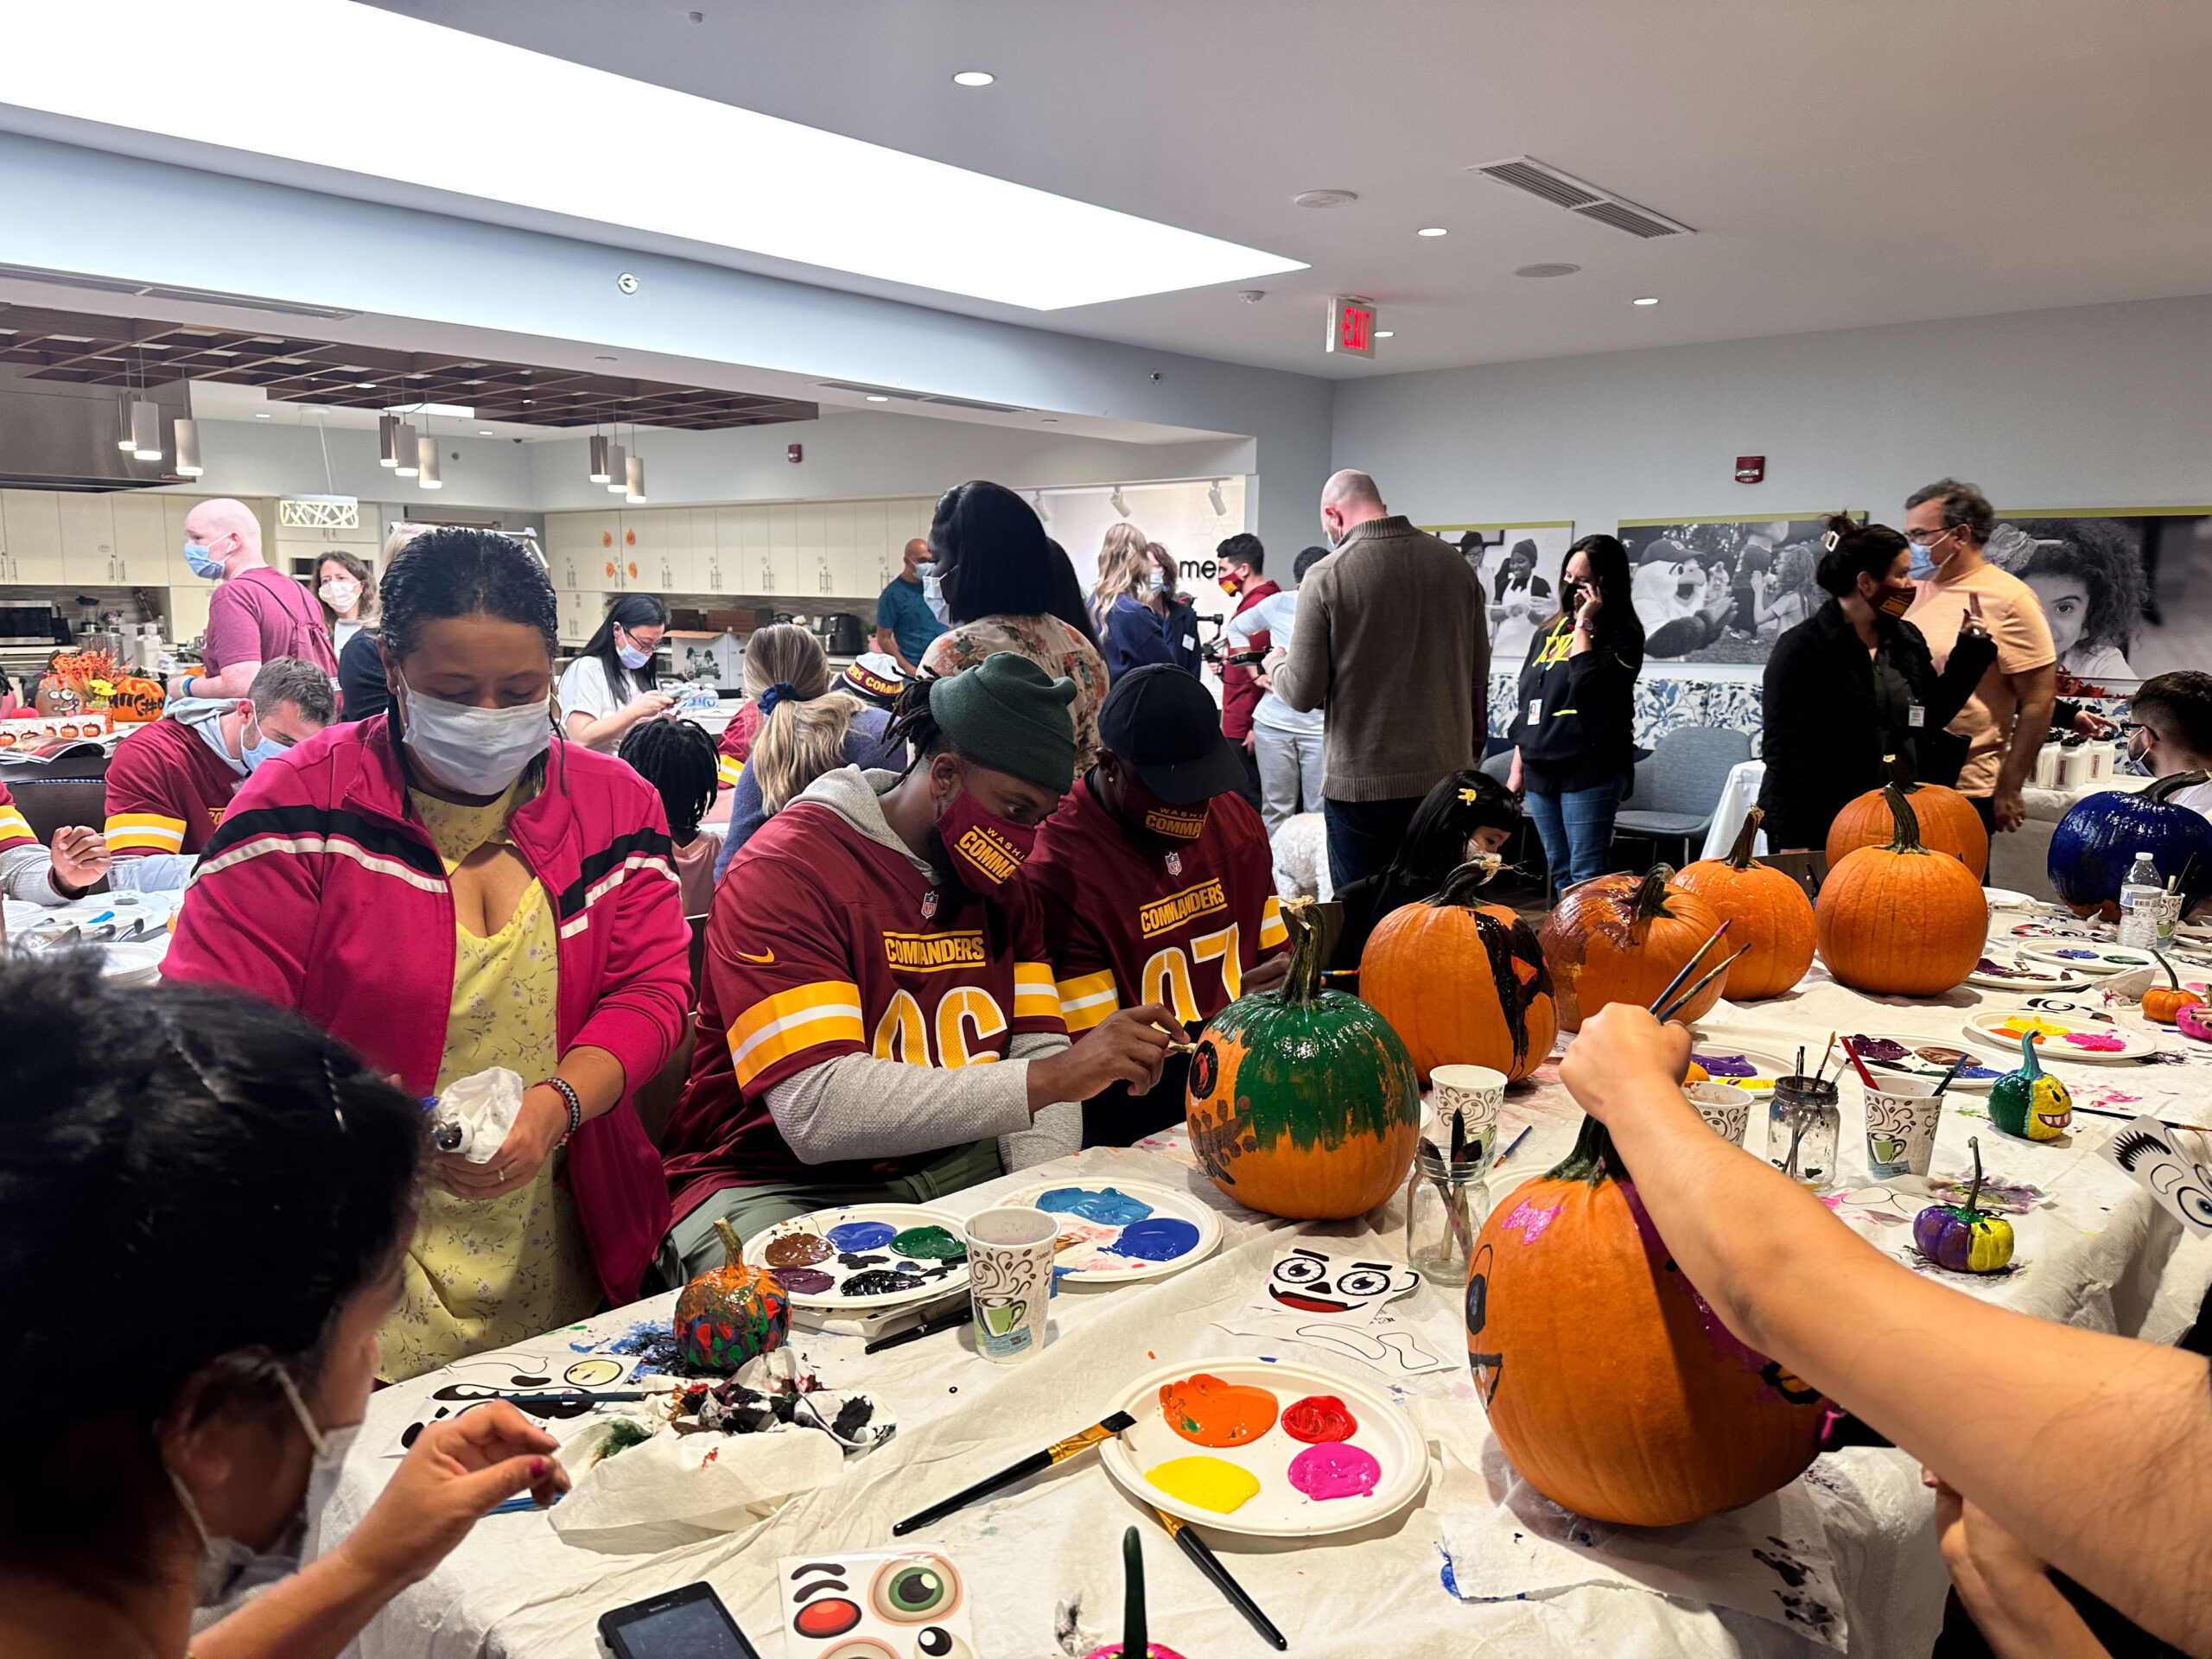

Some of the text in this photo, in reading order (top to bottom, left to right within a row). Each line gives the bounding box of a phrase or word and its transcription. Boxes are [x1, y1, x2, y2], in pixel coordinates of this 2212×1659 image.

[1343, 307, 1371, 352] EXIT
[1141, 883, 1225, 932] COMMANDERS
[884, 937, 985, 965] COMANDERS
